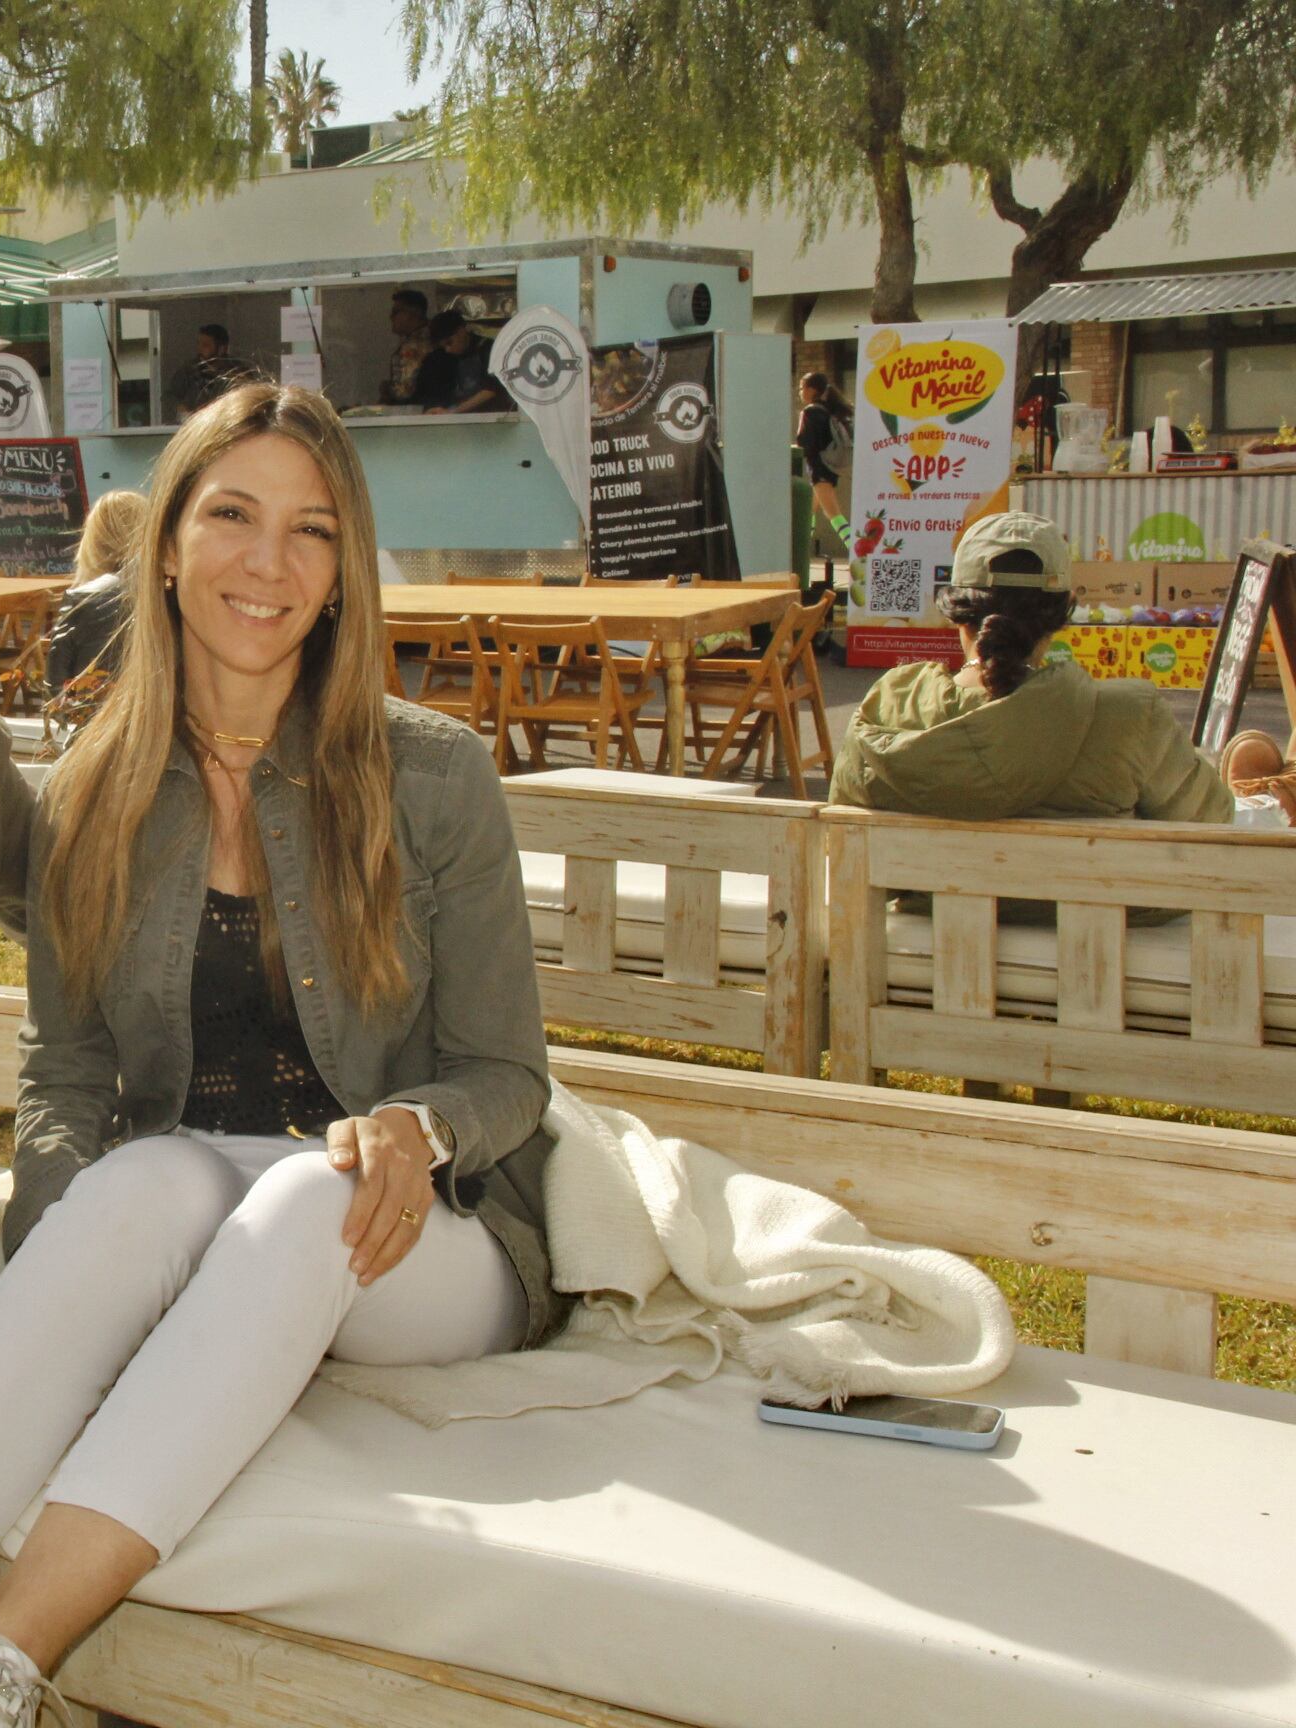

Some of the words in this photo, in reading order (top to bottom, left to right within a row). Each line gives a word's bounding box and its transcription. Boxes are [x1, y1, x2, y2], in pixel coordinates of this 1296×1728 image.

[879, 349, 976, 390] Vitamina
[911, 370, 986, 408] Móvil
[590, 439, 610, 456] OD
[612, 434, 650, 452] TRUCK
[872, 431, 914, 452] Descarga
[917, 429, 957, 441] nuestra
[959, 432, 990, 449] nueva
[590, 461, 625, 479] OCINA
[628, 458, 644, 474] EN
[646, 453, 675, 471] VIVO
[907, 454, 950, 480] APP
[591, 481, 642, 501] ATERING
